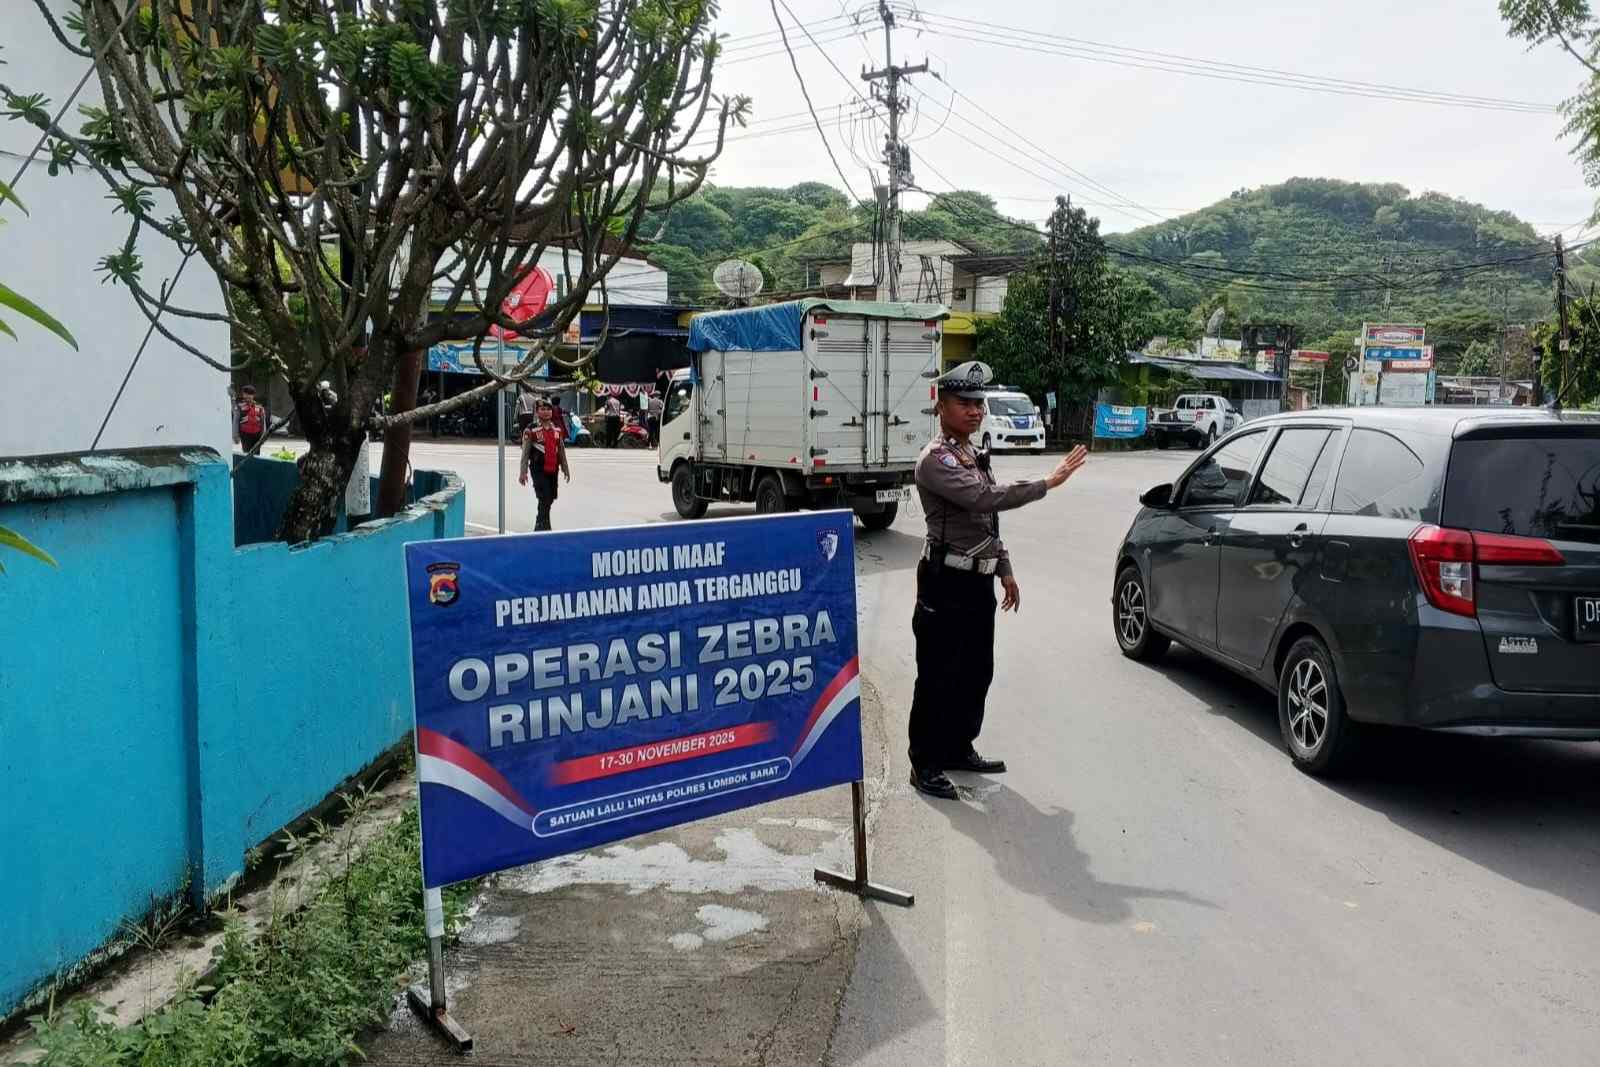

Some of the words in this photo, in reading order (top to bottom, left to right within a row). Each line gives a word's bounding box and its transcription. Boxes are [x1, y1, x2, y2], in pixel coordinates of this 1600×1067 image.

[592, 546, 669, 578] MOHON
[673, 541, 726, 570] MAAF
[495, 586, 633, 627] PERJALANAN
[637, 580, 692, 610] ANDA
[695, 567, 801, 603] TERGANGGU
[448, 630, 681, 700] OPERASI
[697, 610, 837, 663] ZEBRA
[488, 674, 699, 747] RINJANI
[714, 655, 814, 705] 2025
[599, 752, 634, 769] 17-30
[637, 737, 706, 761] NOVEMBER
[709, 732, 735, 747] 2025
[549, 808, 595, 827] SATUAN
[597, 801, 625, 816] LALU
[627, 792, 664, 809] LINTAS
[666, 782, 706, 800] POLRES
[707, 773, 748, 790] LOMBOK
[750, 765, 779, 780] BARAT
